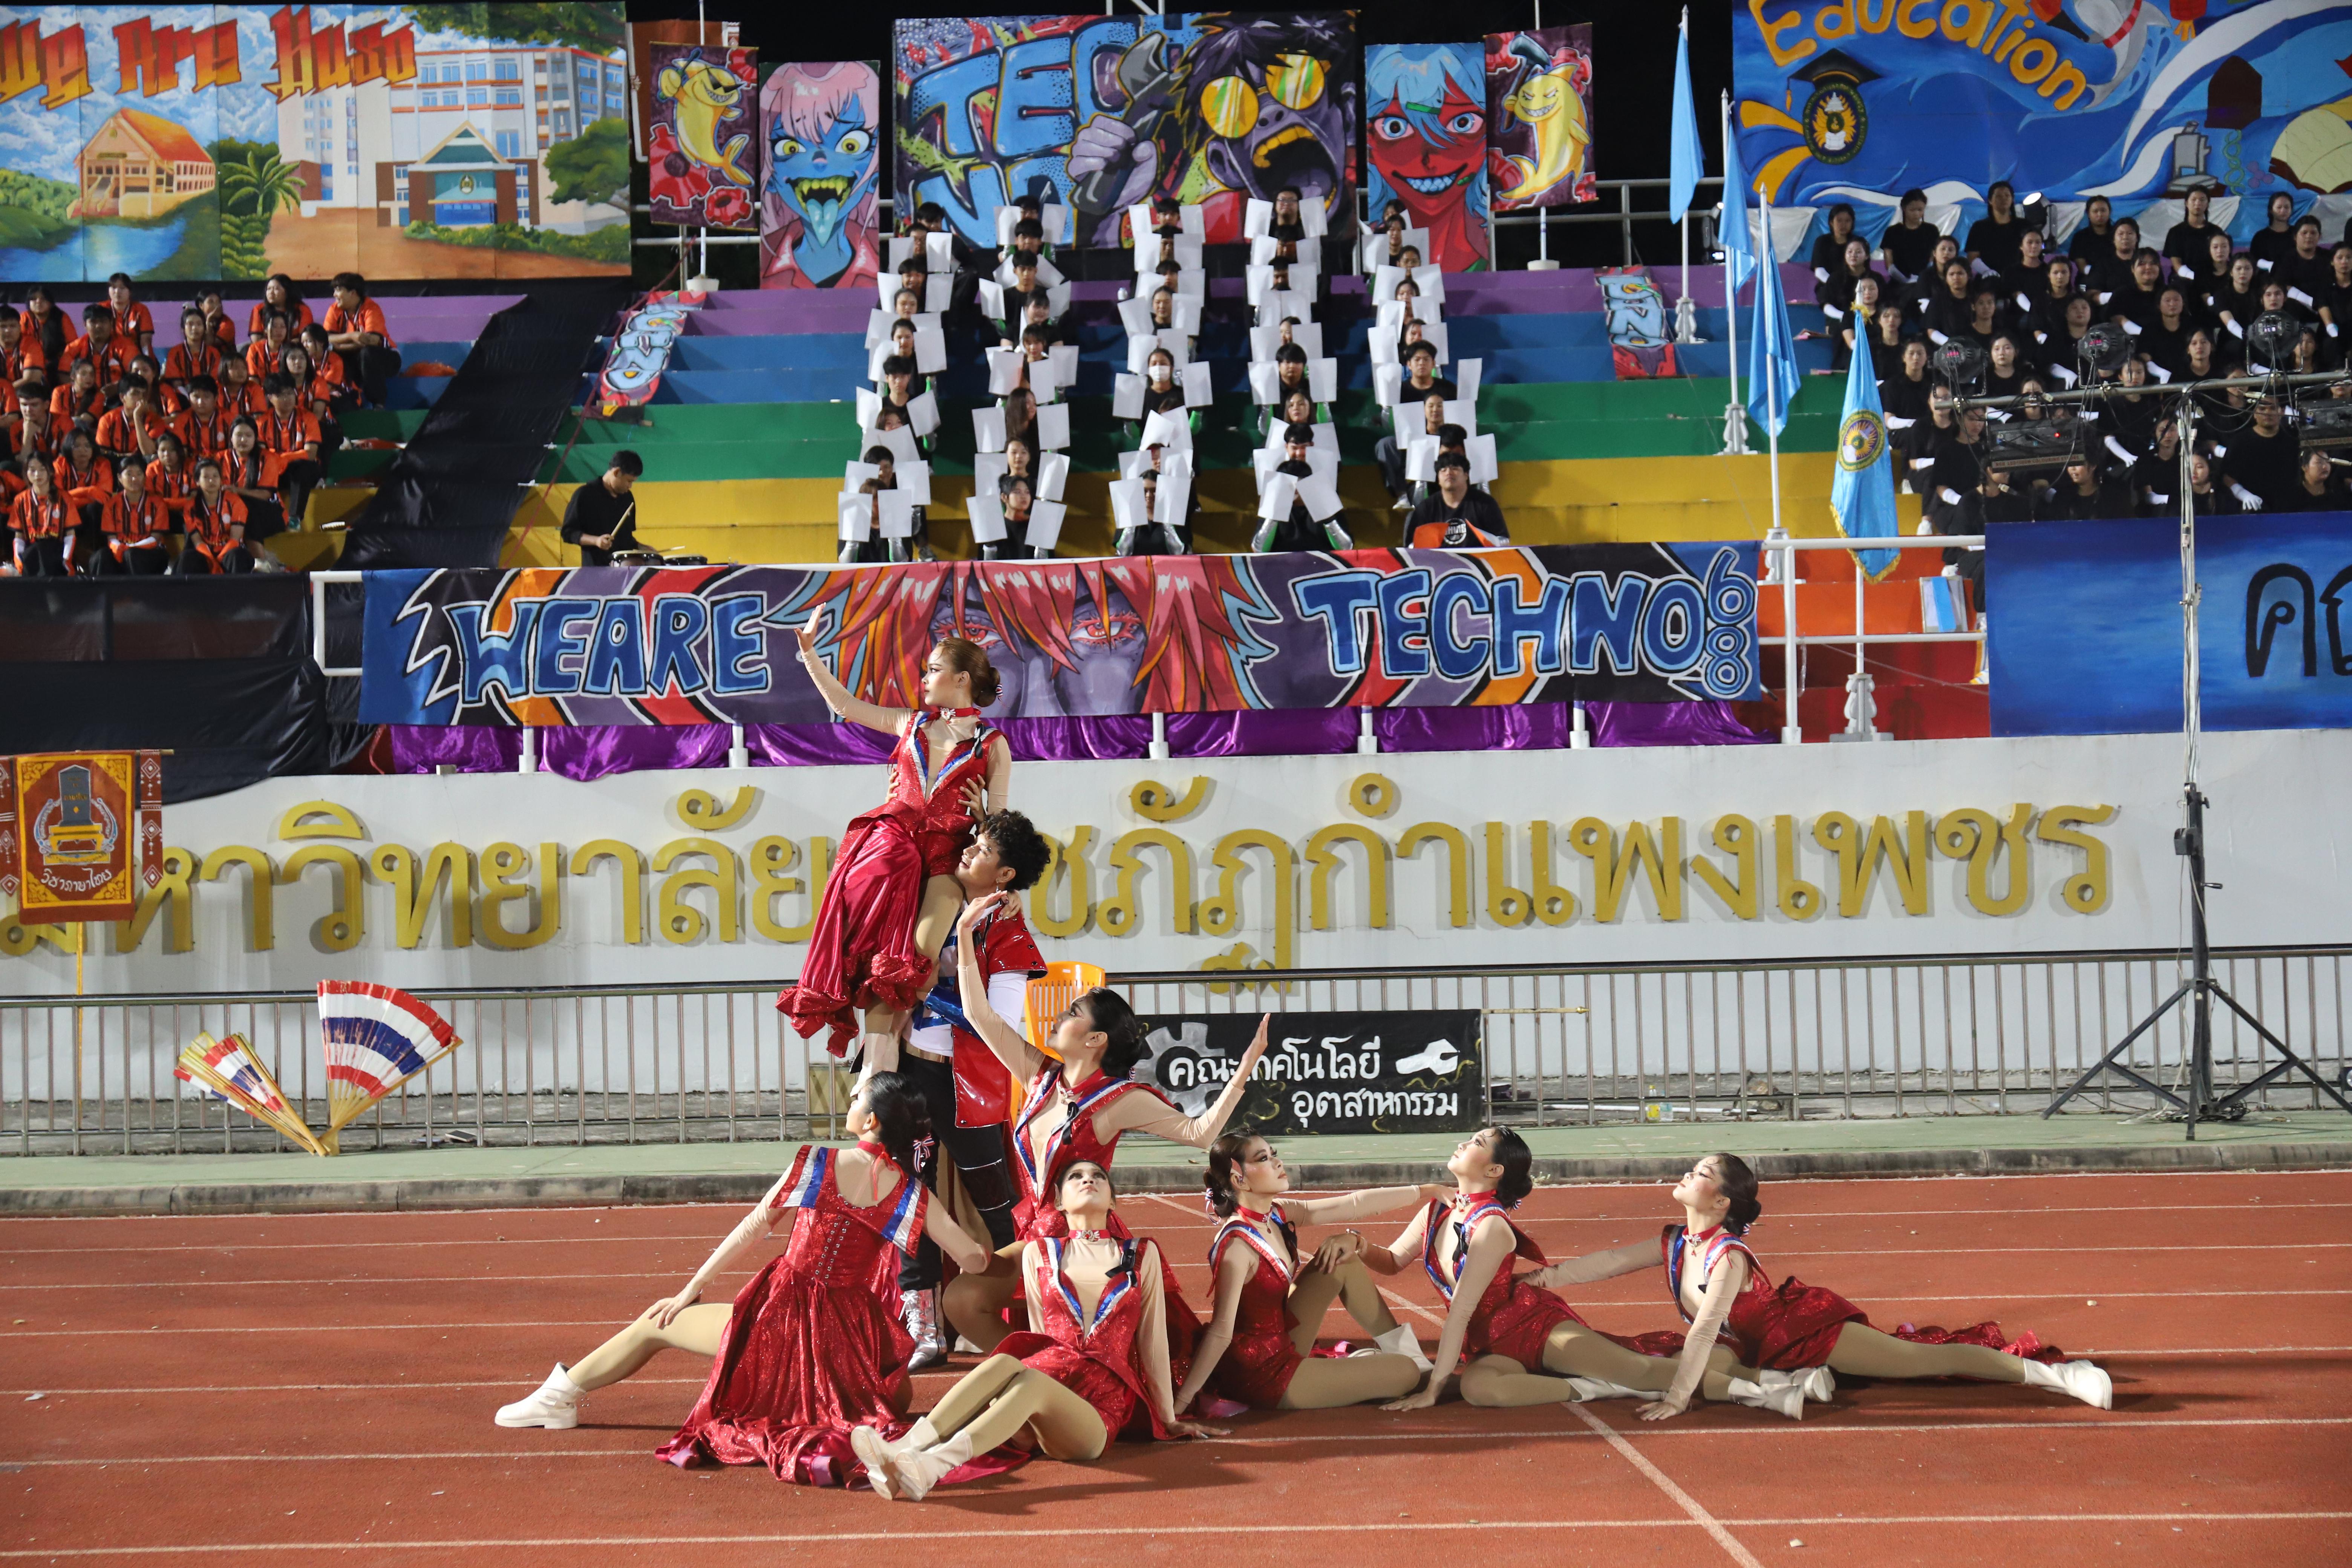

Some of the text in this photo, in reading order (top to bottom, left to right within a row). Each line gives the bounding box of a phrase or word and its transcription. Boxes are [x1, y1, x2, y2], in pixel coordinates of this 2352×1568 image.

[112, 15, 242, 98] Are
[262, 4, 418, 104] Huso
[1289, 569, 1707, 680] TECHNO
[41, 868, 112, 892] วิชาภาษาไทย
[1291, 1088, 1458, 1129] อุตสาหกรรม
